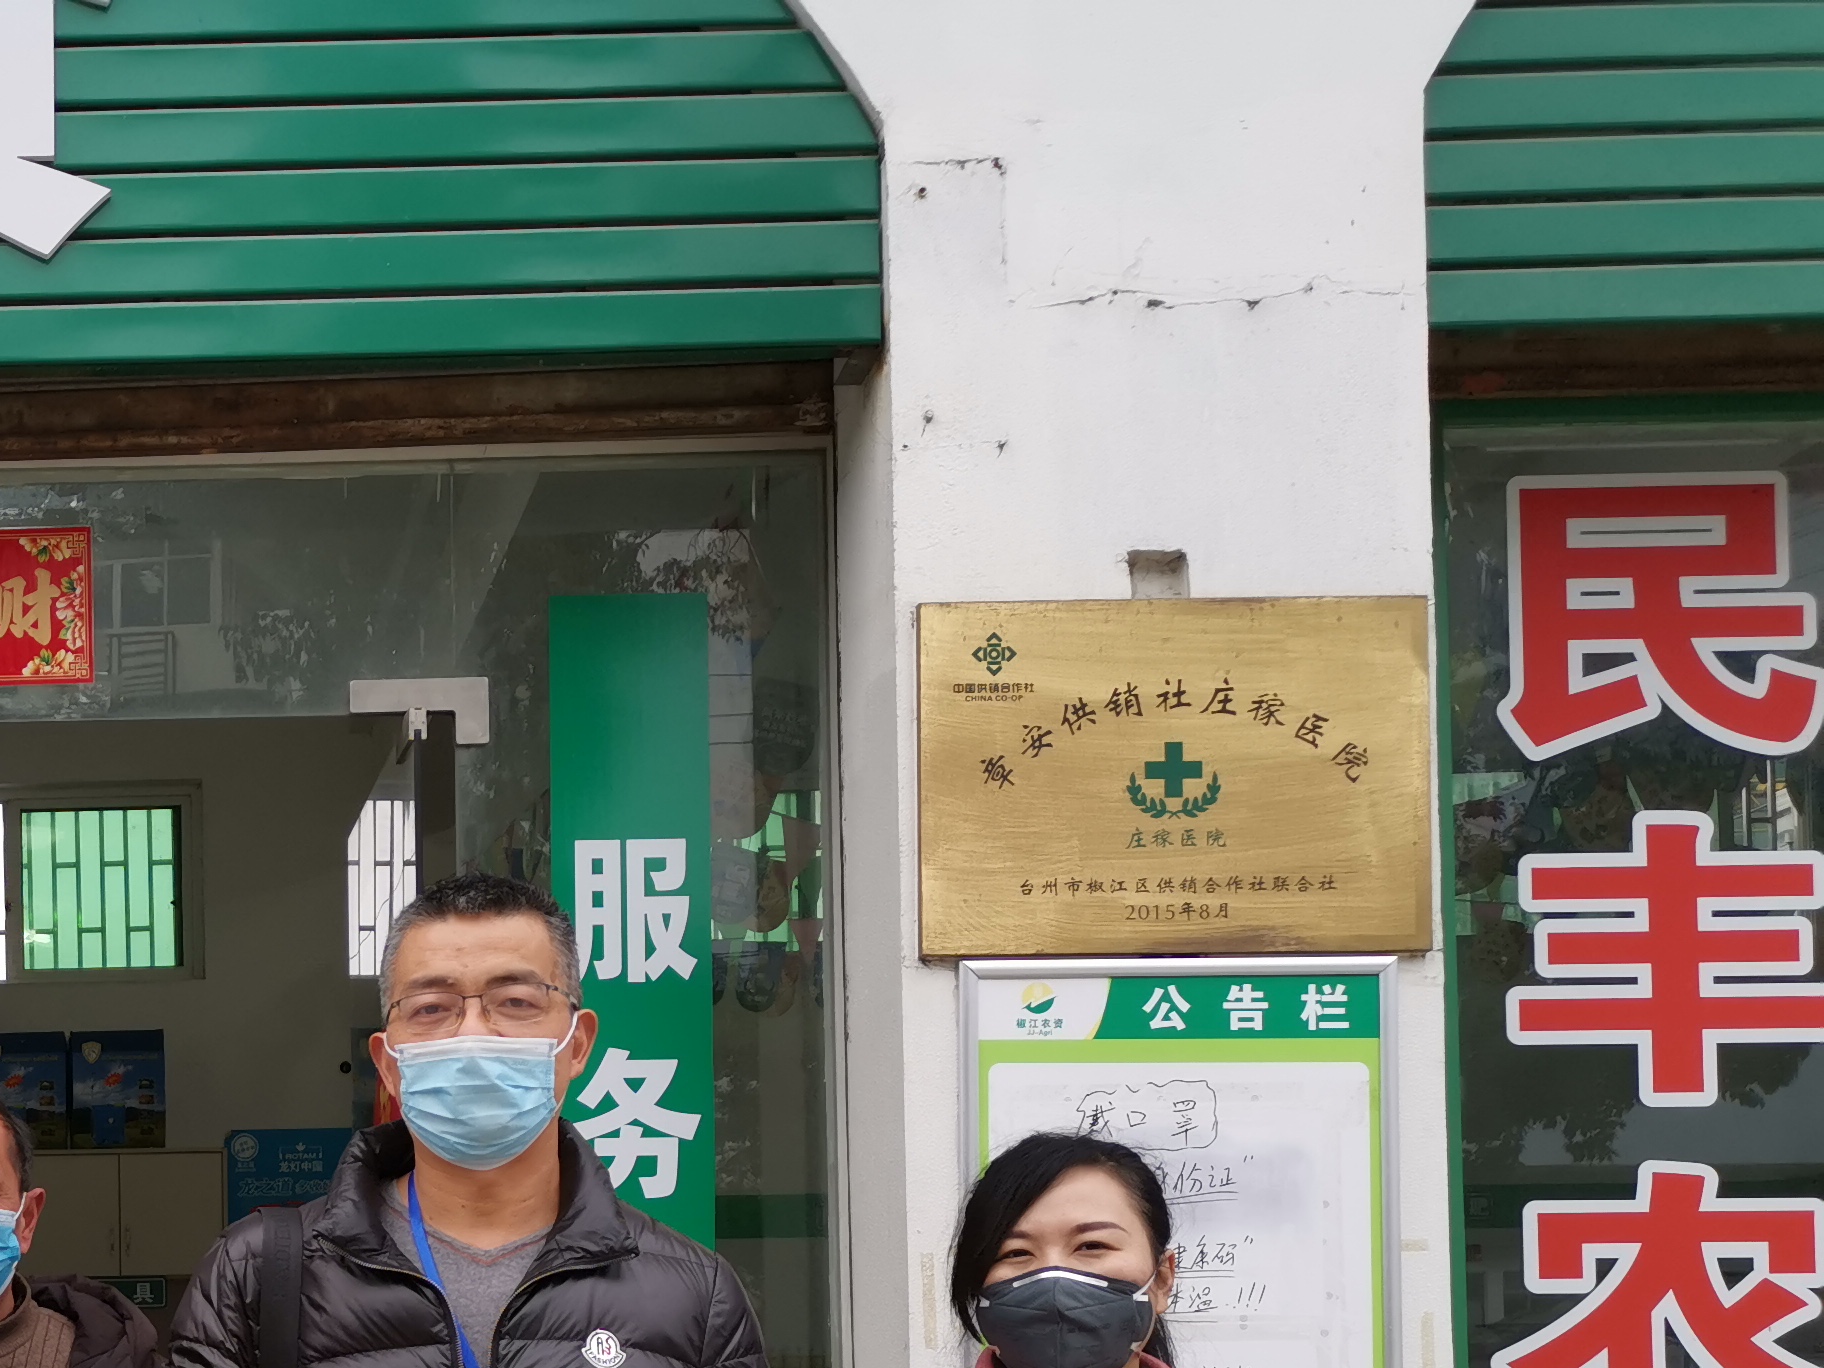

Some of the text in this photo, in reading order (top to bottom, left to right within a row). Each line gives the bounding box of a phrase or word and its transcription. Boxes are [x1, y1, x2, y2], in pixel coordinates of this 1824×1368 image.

[953, 682, 1035, 694] 中国供销合作社
[995, 694, 1024, 702] CO-OP
[978, 676, 1370, 790] 章安供销社庄稼医院
[1125, 827, 1228, 849] 庄稼医院
[1019, 875, 1339, 897] 台州市椒江区供销合作社联合社
[1124, 901, 1230, 921] 2015年8月
[574, 838, 702, 1198] 服务
[1142, 983, 1351, 1033] 公告栏
[1016, 1017, 1064, 1029] 椒江农资
[279, 1160, 323, 1173] 龙灯中国
[133, 1282, 155, 1304] 具
